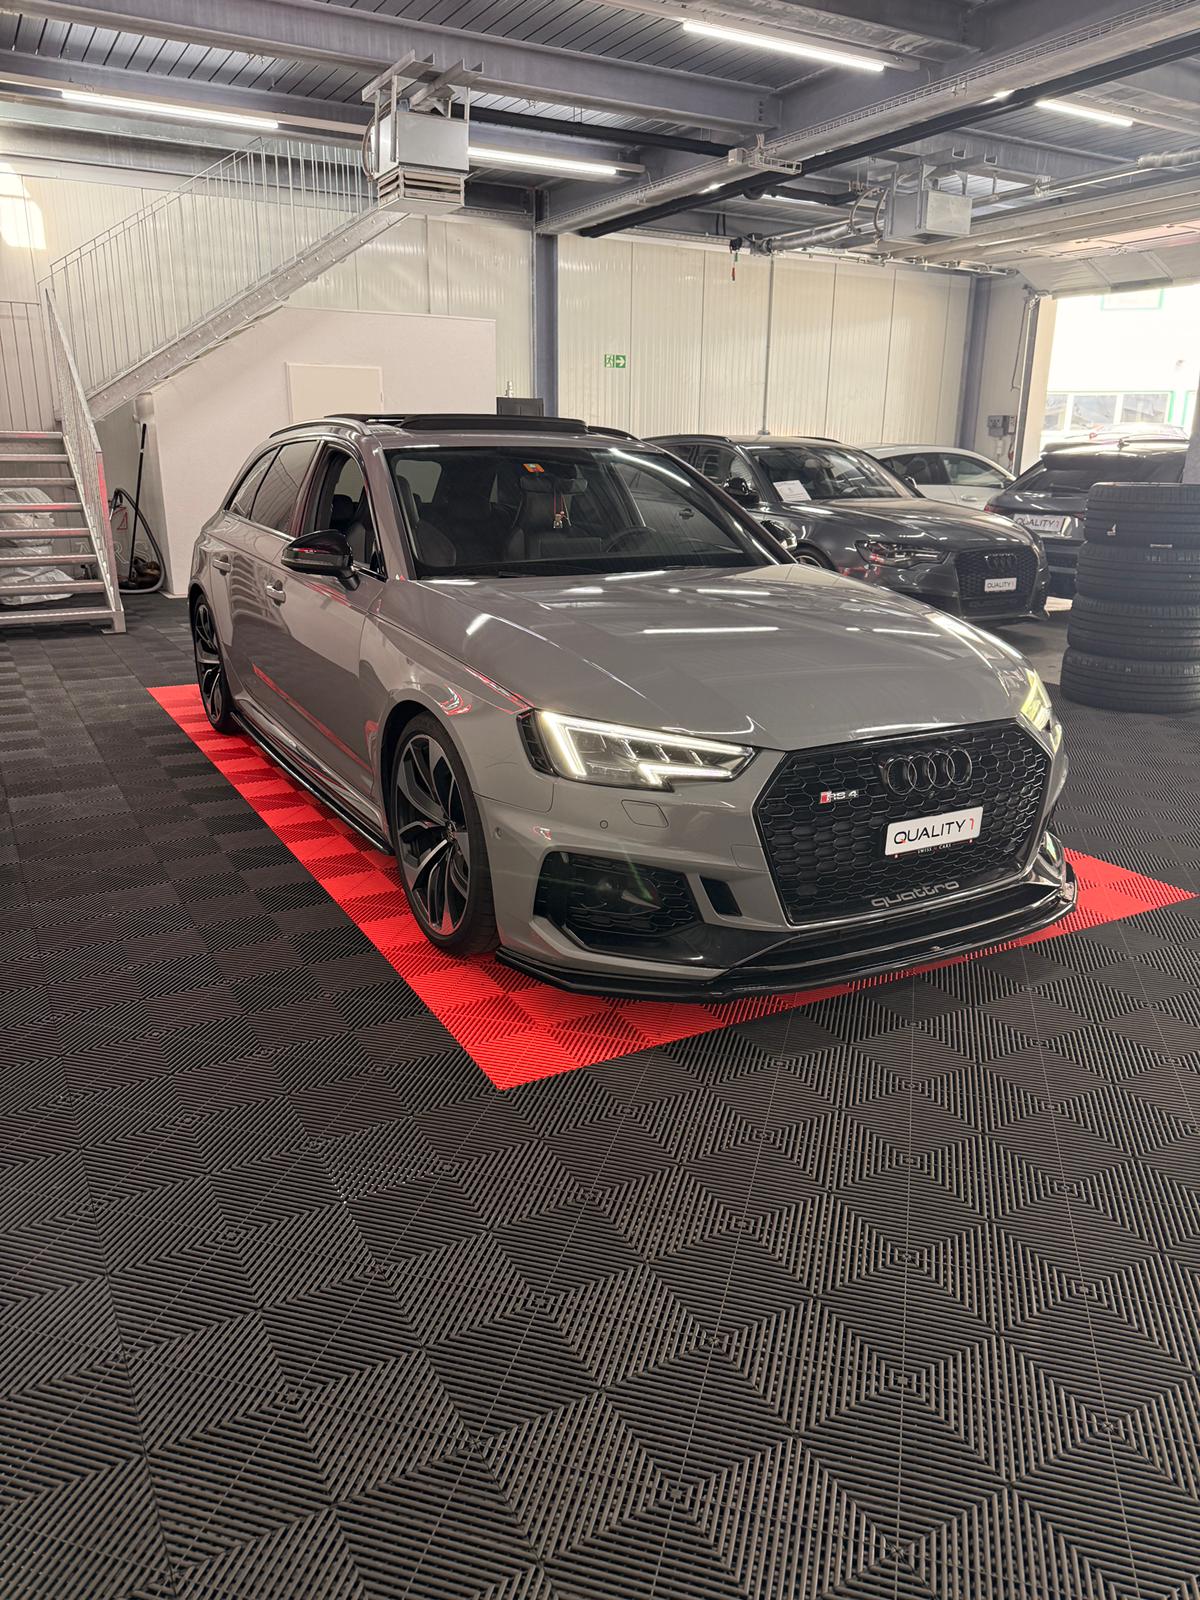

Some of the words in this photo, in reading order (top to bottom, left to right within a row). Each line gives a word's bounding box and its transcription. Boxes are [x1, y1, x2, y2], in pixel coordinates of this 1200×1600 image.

[987, 581, 1011, 589] QUALITY
[826, 791, 846, 803] RS
[848, 790, 858, 798] 4
[894, 819, 967, 845] QUALITY
[969, 818, 975, 831] 1
[871, 880, 960, 907] quattro
